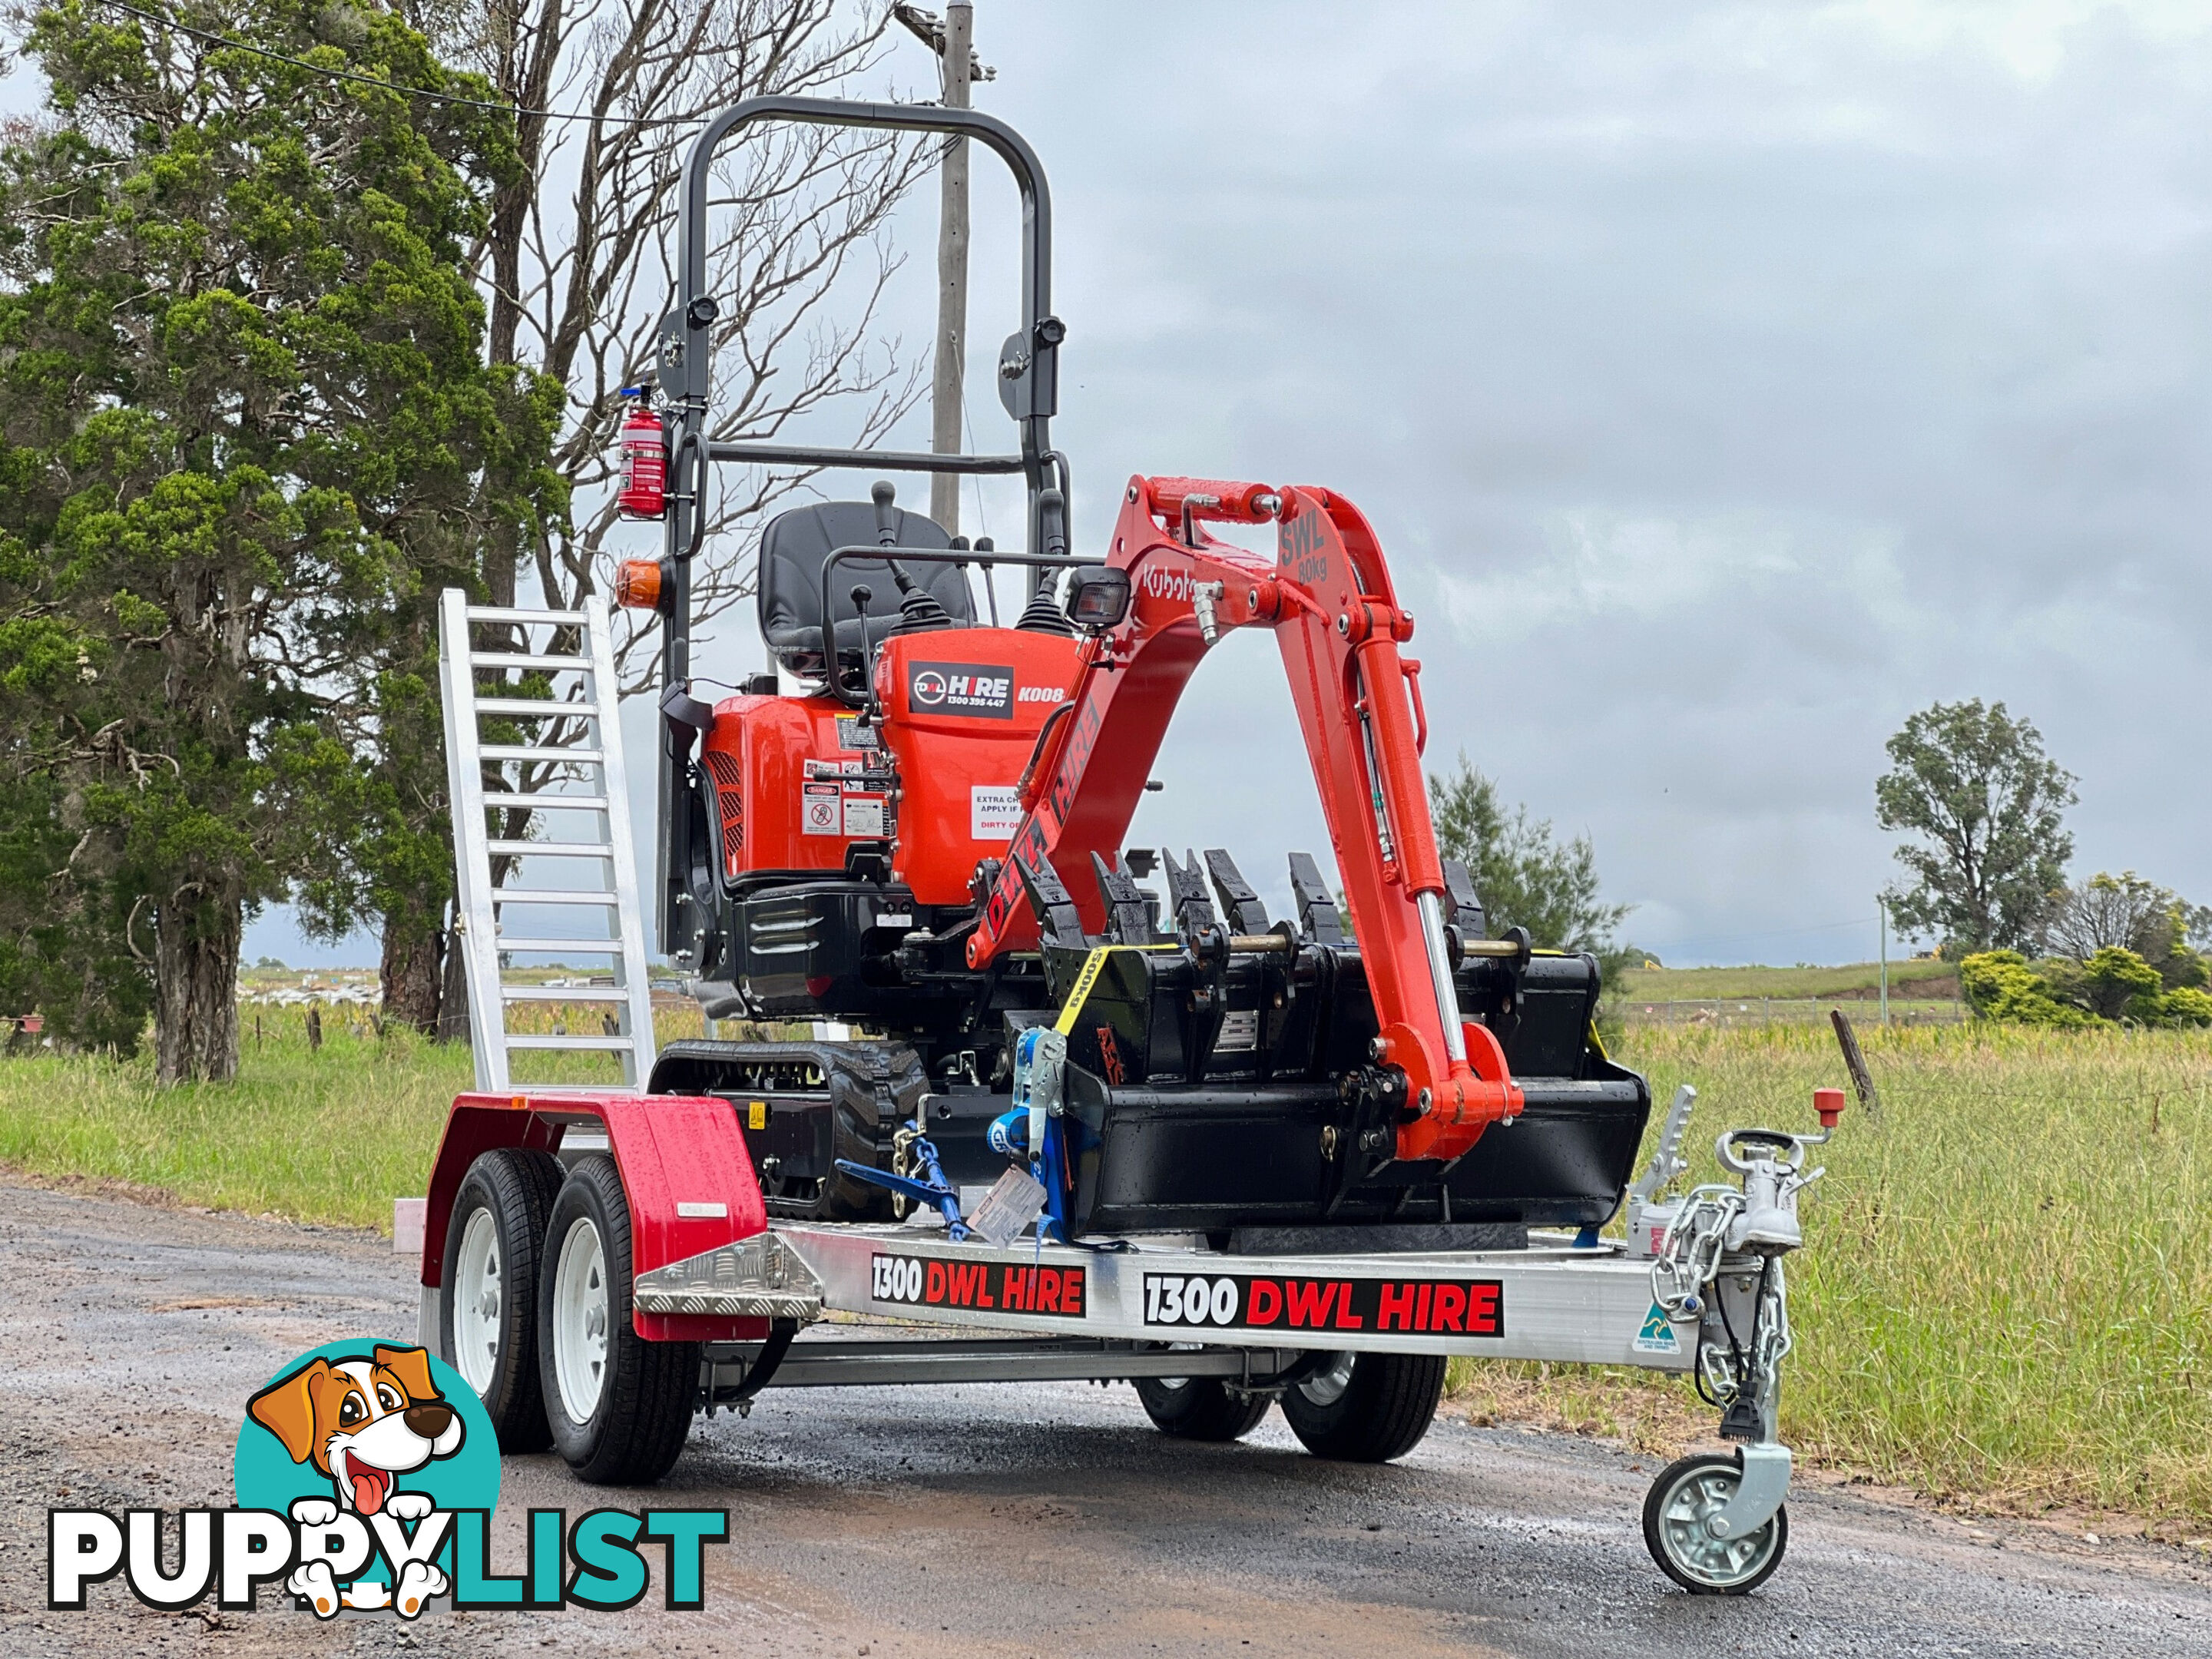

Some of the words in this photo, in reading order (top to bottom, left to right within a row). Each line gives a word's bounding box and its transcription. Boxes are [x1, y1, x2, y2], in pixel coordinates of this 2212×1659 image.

[1281, 508, 1325, 566] SWL
[1298, 556, 1327, 586] 80kg
[947, 696, 969, 705] 1300
[969, 698, 986, 707] 395
[986, 699, 1005, 707] 447
[948, 675, 1009, 698] HIRE
[1055, 701, 1098, 820] HIRE
[873, 1257, 922, 1303] 1300
[926, 1261, 994, 1307] DWL
[1002, 1267, 1084, 1313] HIRE
[1147, 1277, 1239, 1326] 1300
[1246, 1280, 1363, 1329] DWL
[1377, 1283, 1500, 1333] HIRE
